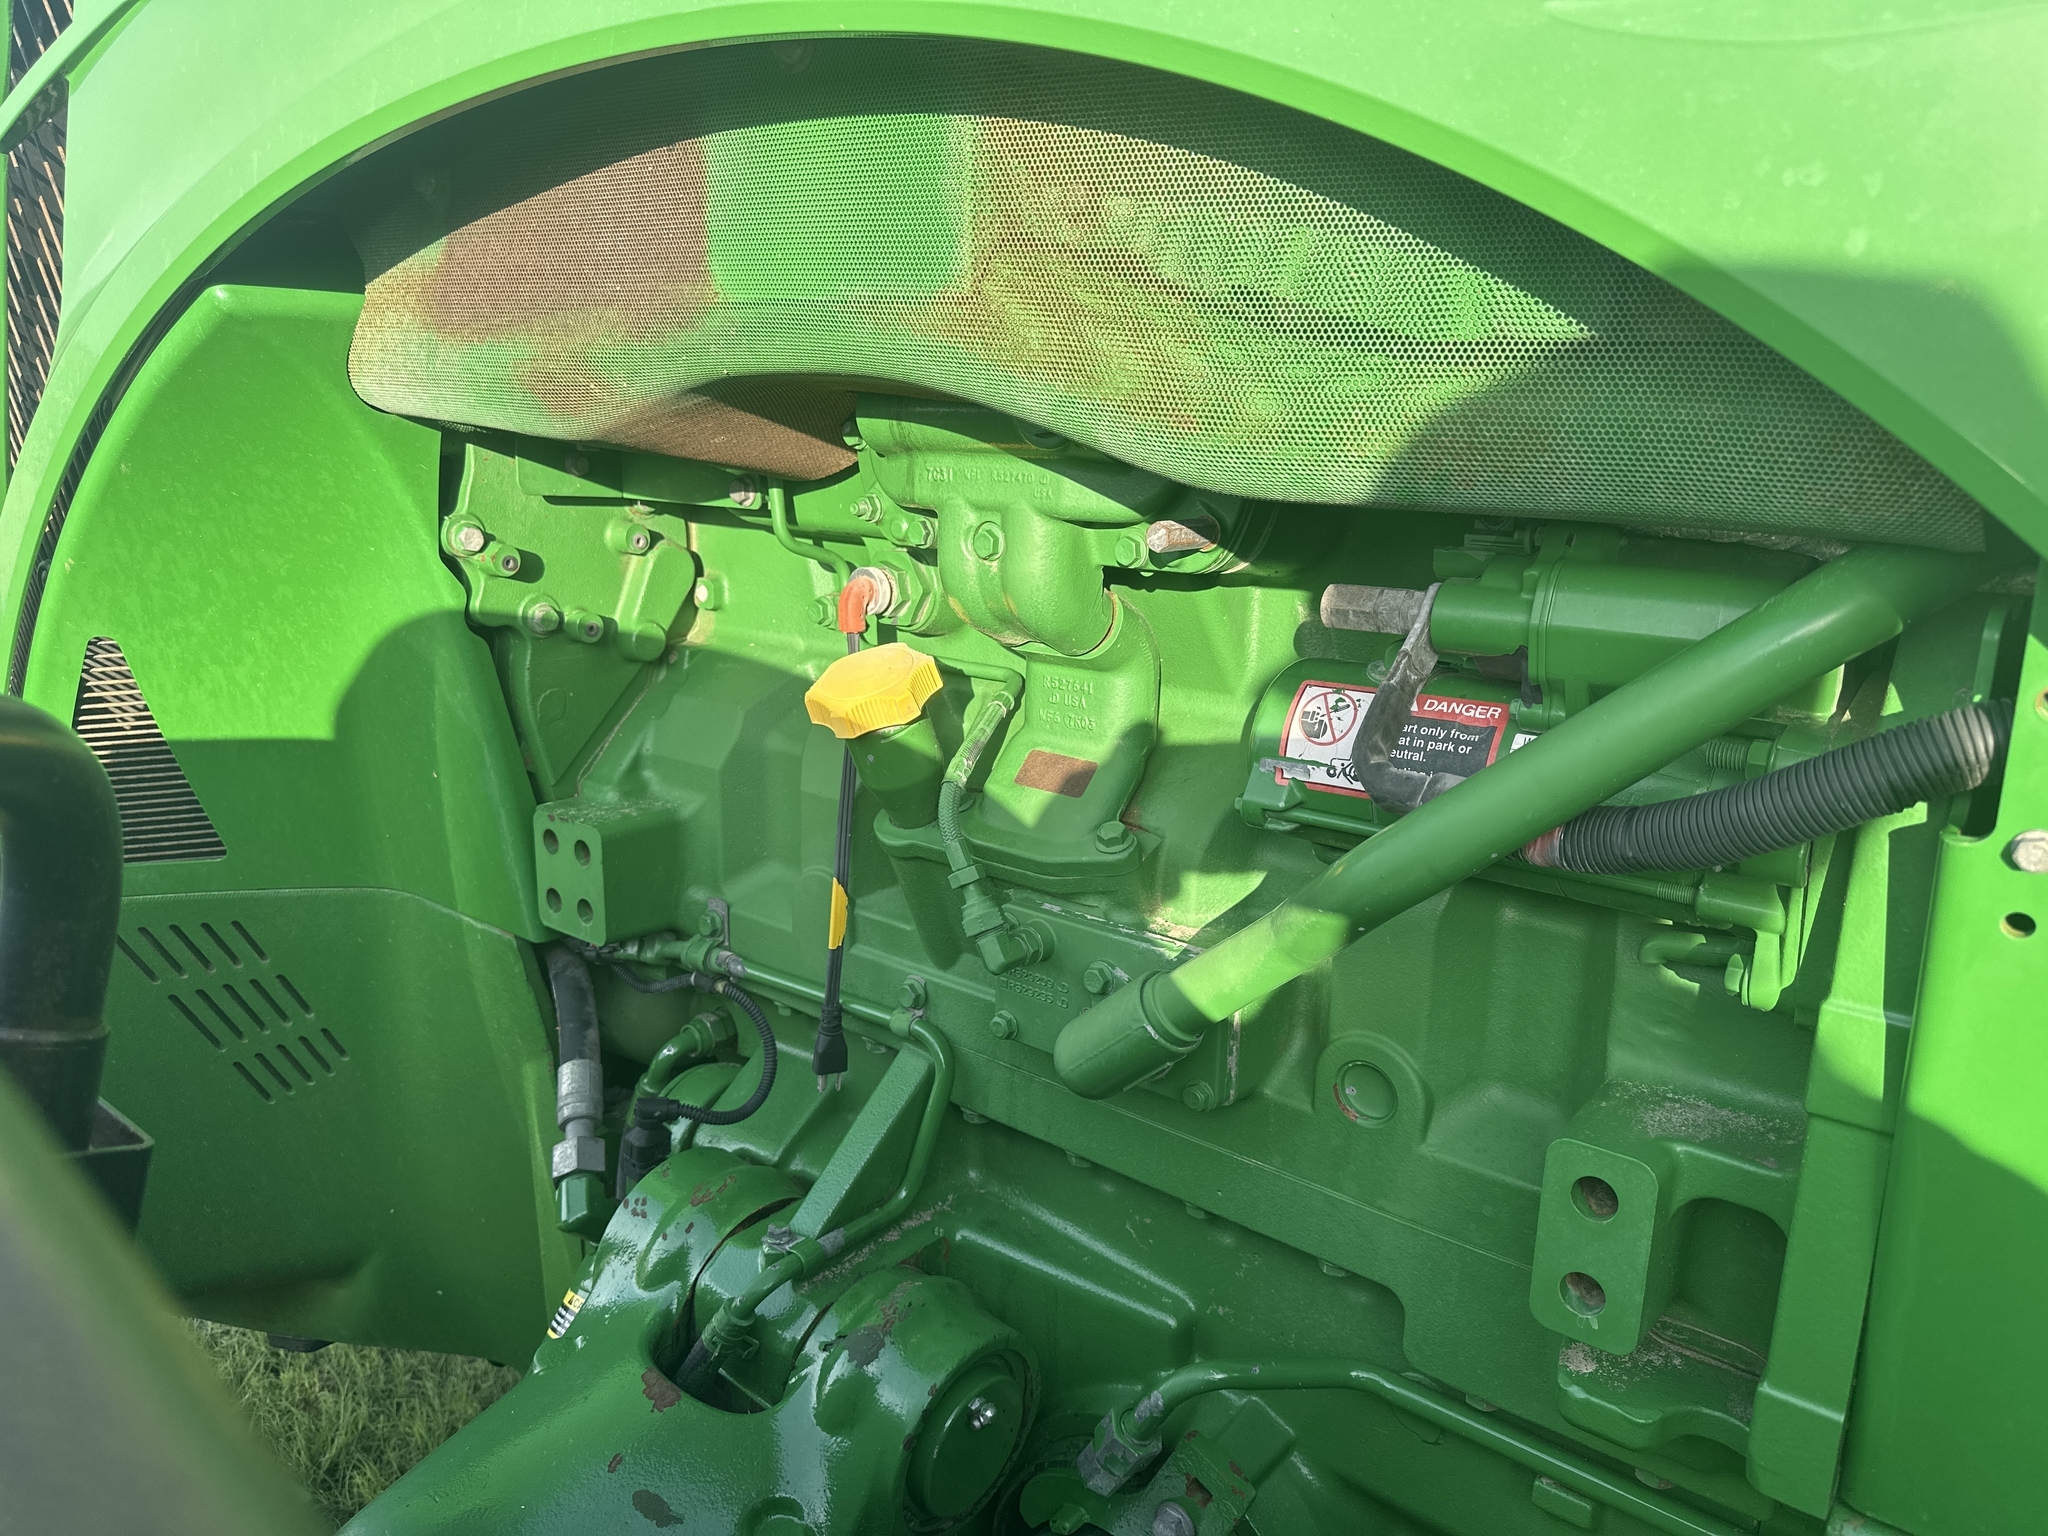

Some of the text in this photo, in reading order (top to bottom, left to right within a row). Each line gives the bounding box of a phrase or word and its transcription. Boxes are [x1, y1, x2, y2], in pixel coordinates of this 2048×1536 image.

[1033, 487, 1053, 500] USA
[1042, 675, 1094, 695] R527641
[1064, 693, 1087, 709] USA
[1423, 698, 1502, 719] DANGER
[1420, 726, 1448, 740] only
[1450, 728, 1479, 742] from
[1412, 736, 1425, 748] in
[1426, 739, 1456, 752] park
[1457, 744, 1472, 755] or
[1389, 748, 1427, 763] eutral.
